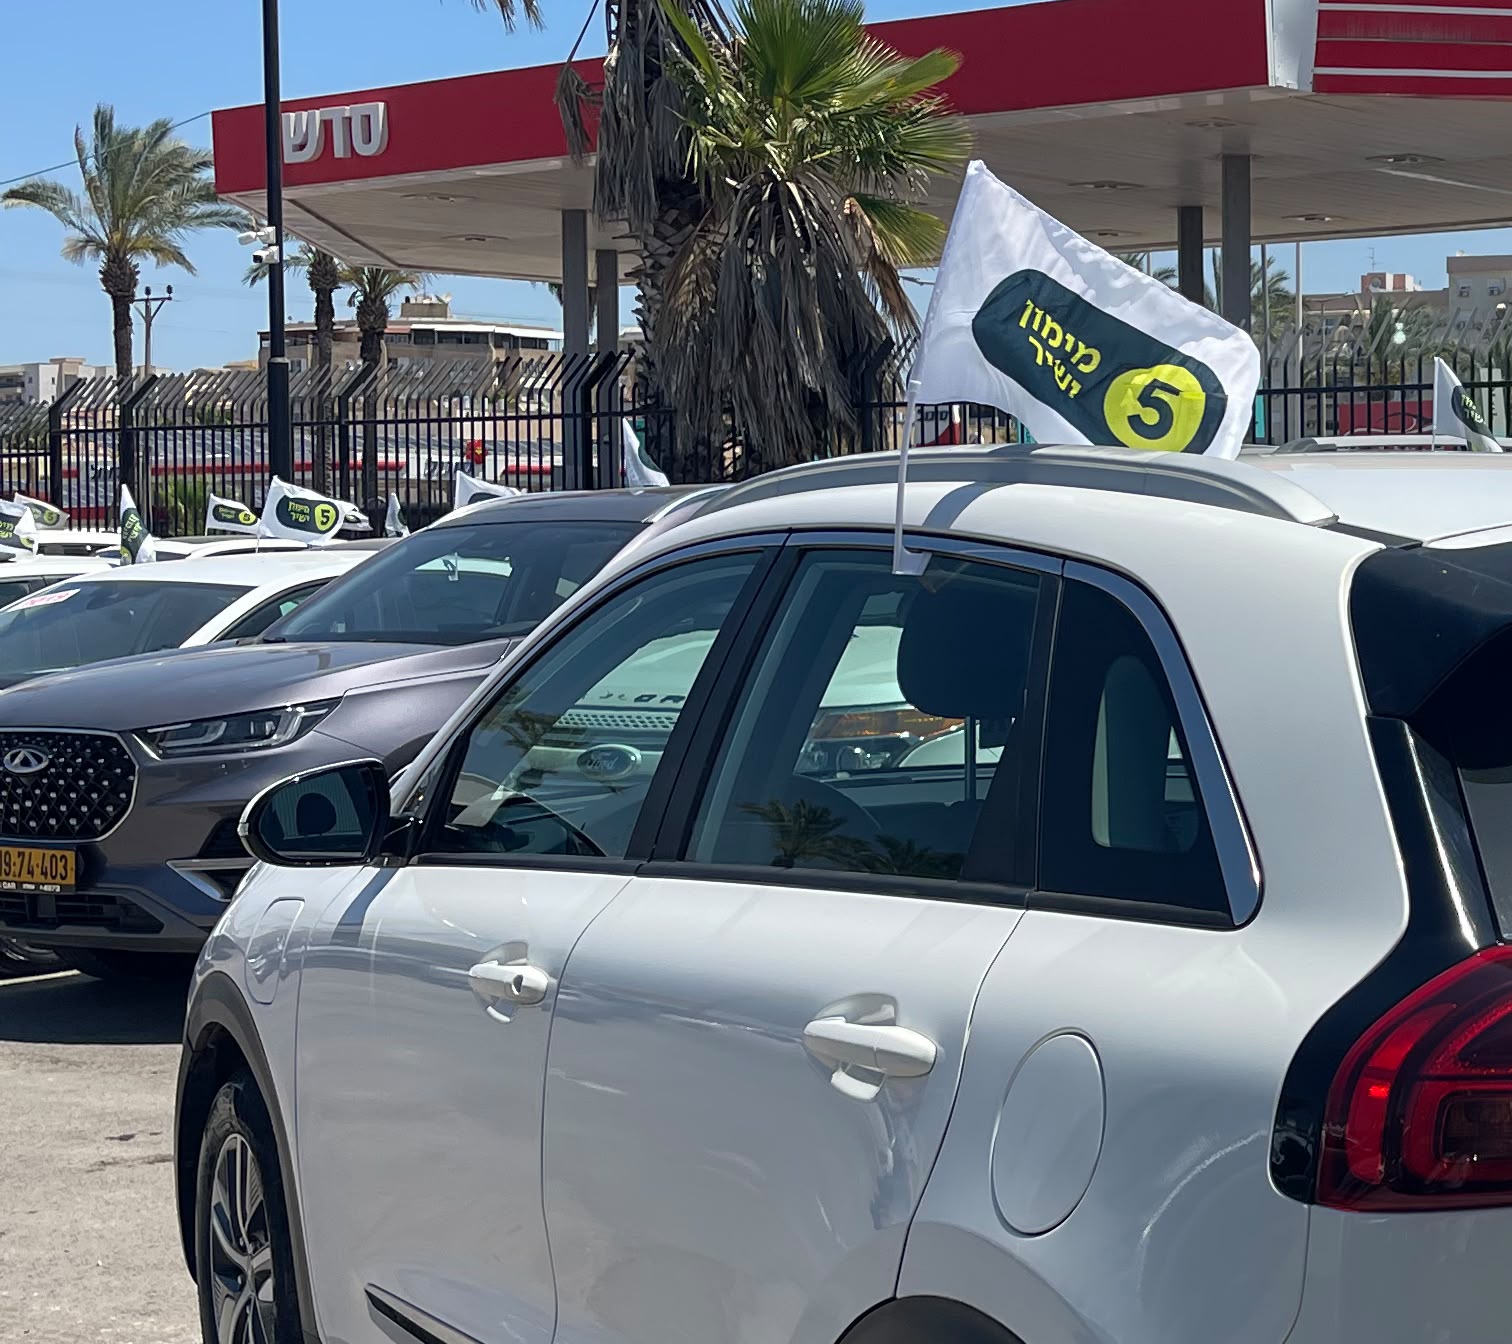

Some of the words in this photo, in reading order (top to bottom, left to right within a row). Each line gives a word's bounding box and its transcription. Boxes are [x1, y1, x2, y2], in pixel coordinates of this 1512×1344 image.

[281, 102, 388, 164] סדש
[1018, 299, 1101, 374] מימון
[1028, 335, 1083, 399] ישיר
[1127, 378, 1180, 440] 5
[320, 509, 330, 526] 5
